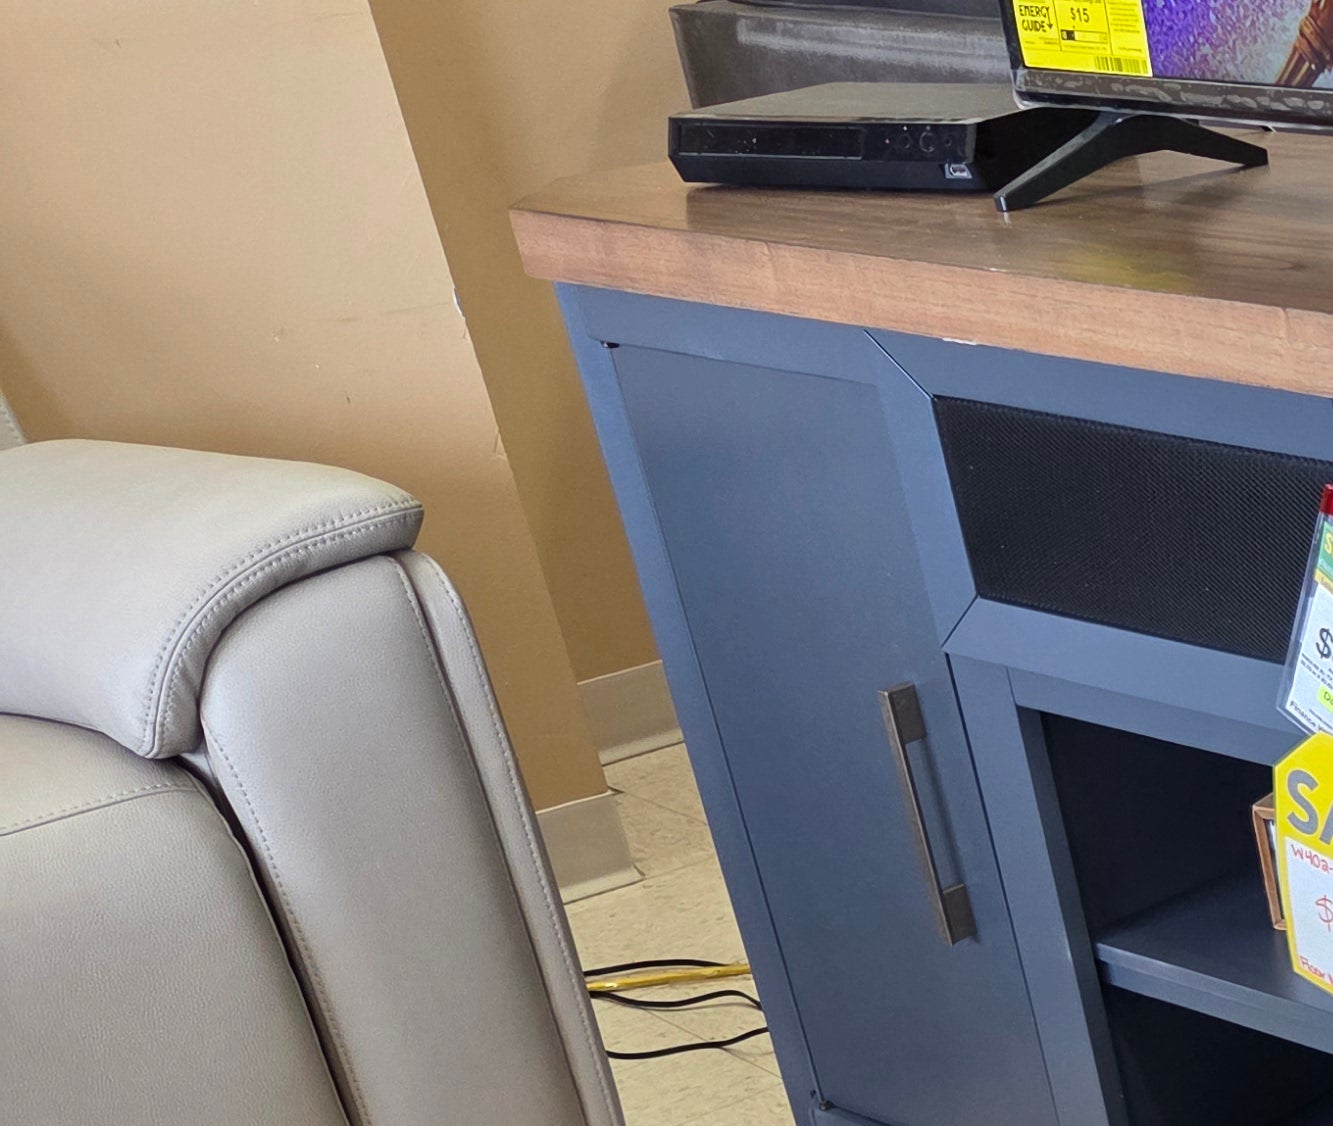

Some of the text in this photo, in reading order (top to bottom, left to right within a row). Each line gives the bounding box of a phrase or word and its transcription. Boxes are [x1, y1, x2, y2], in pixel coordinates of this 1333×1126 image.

[1019, 5, 1049, 18] ENERGY
[1070, 7, 1089, 23] $15
[1021, 19, 1046, 32] GUIDE
